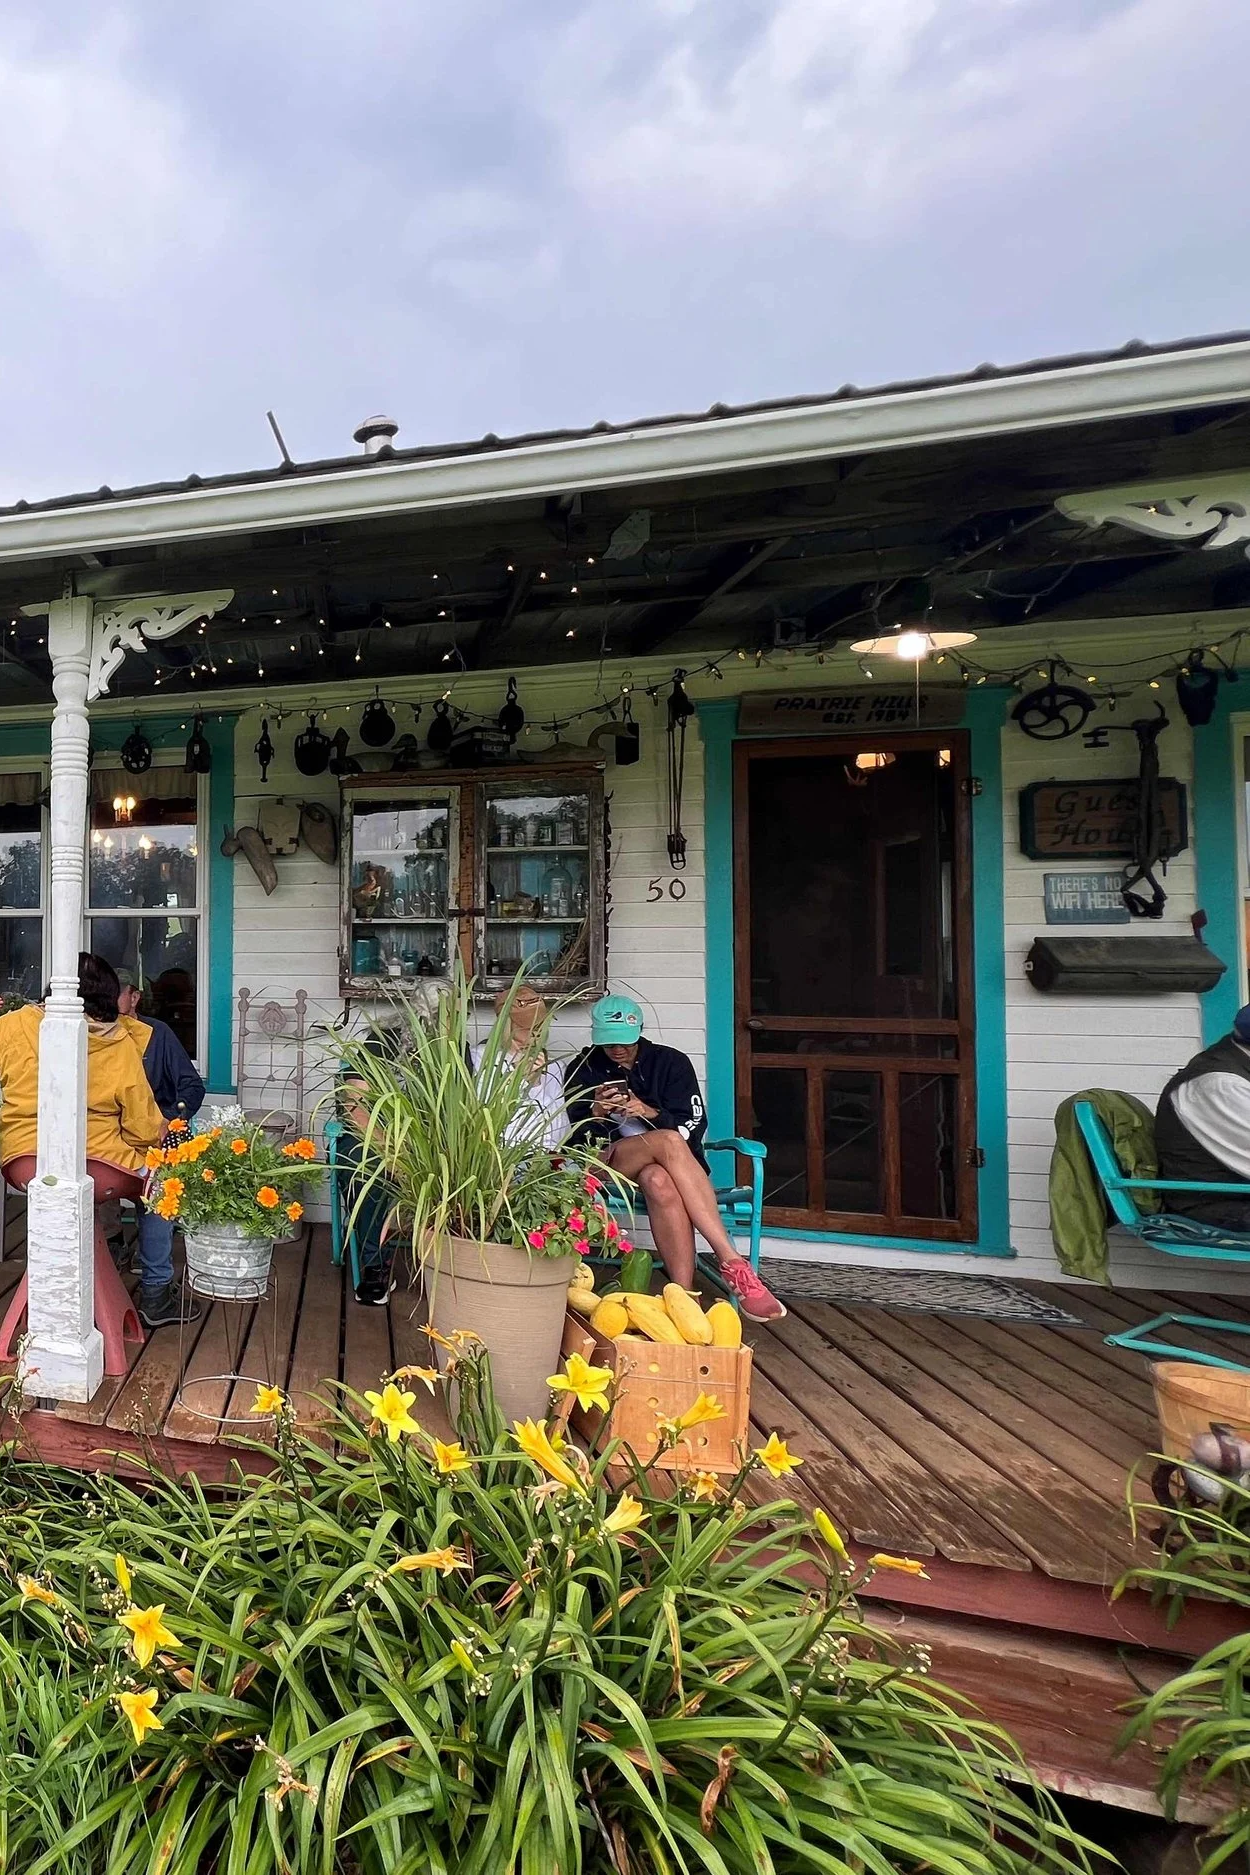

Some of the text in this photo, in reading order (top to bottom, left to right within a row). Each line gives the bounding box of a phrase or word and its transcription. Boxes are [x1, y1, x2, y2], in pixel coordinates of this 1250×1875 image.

[774, 696, 866, 711] PRAIRIE
[646, 876, 686, 903] 50
[1050, 875, 1122, 892] THERE'S NO
[1051, 892, 1080, 910] WIFI
